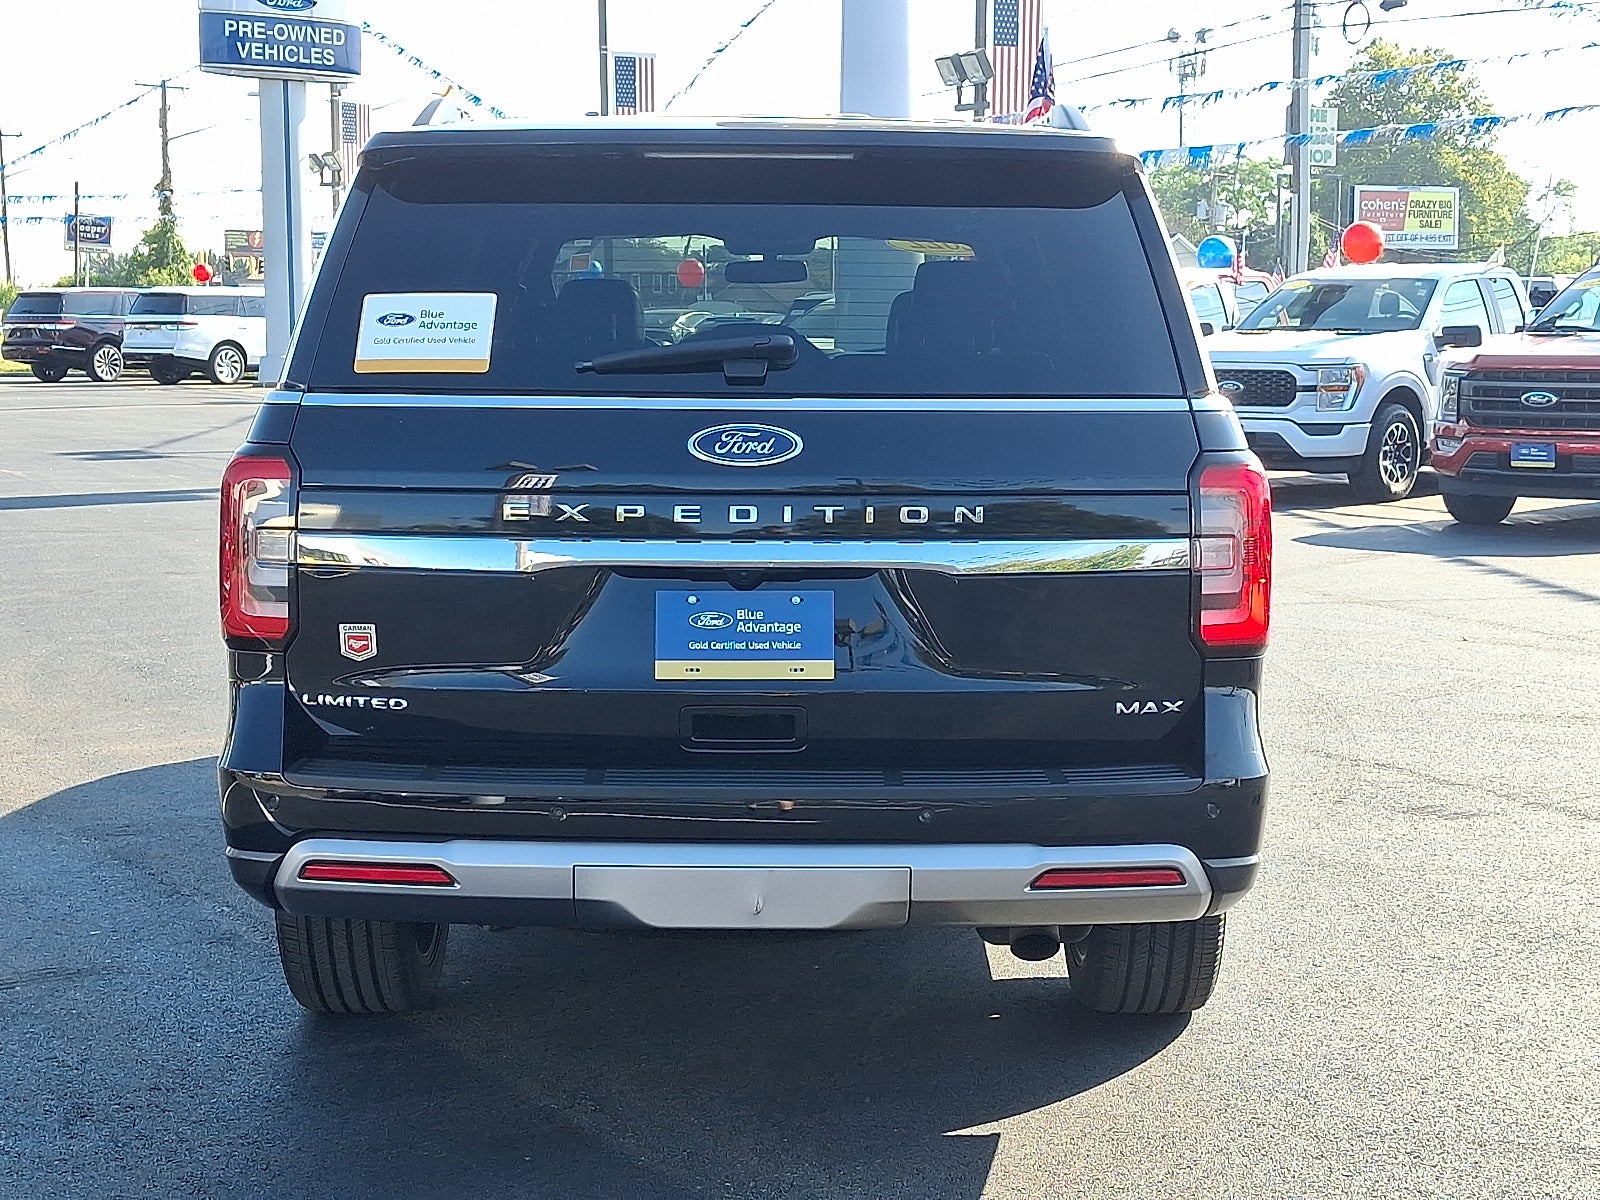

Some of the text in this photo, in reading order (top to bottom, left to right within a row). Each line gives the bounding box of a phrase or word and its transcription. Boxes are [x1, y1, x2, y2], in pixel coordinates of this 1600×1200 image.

[224, 19, 345, 46] PRE-OWNED
[236, 42, 335, 66] VEHICLES
[1361, 197, 1406, 211] cohen's
[1409, 200, 1453, 209] CRAZY BIG
[1362, 210, 1404, 218] furniture
[1408, 209, 1453, 219] FURNITURE
[383, 313, 409, 325] Ford
[420, 309, 445, 319] Blue
[418, 319, 478, 332] Advantage
[373, 336, 476, 345] Gold Certified Used Vehicle
[714, 430, 776, 455] Ford
[503, 503, 985, 526] EXPEDITION
[697, 614, 726, 627] Ford
[736, 608, 764, 620] Blue
[736, 621, 802, 635] Advantage
[688, 640, 802, 650] Gold Certified Used Vehicle
[302, 693, 408, 710] LIMITED
[1115, 700, 1184, 715] MAX
